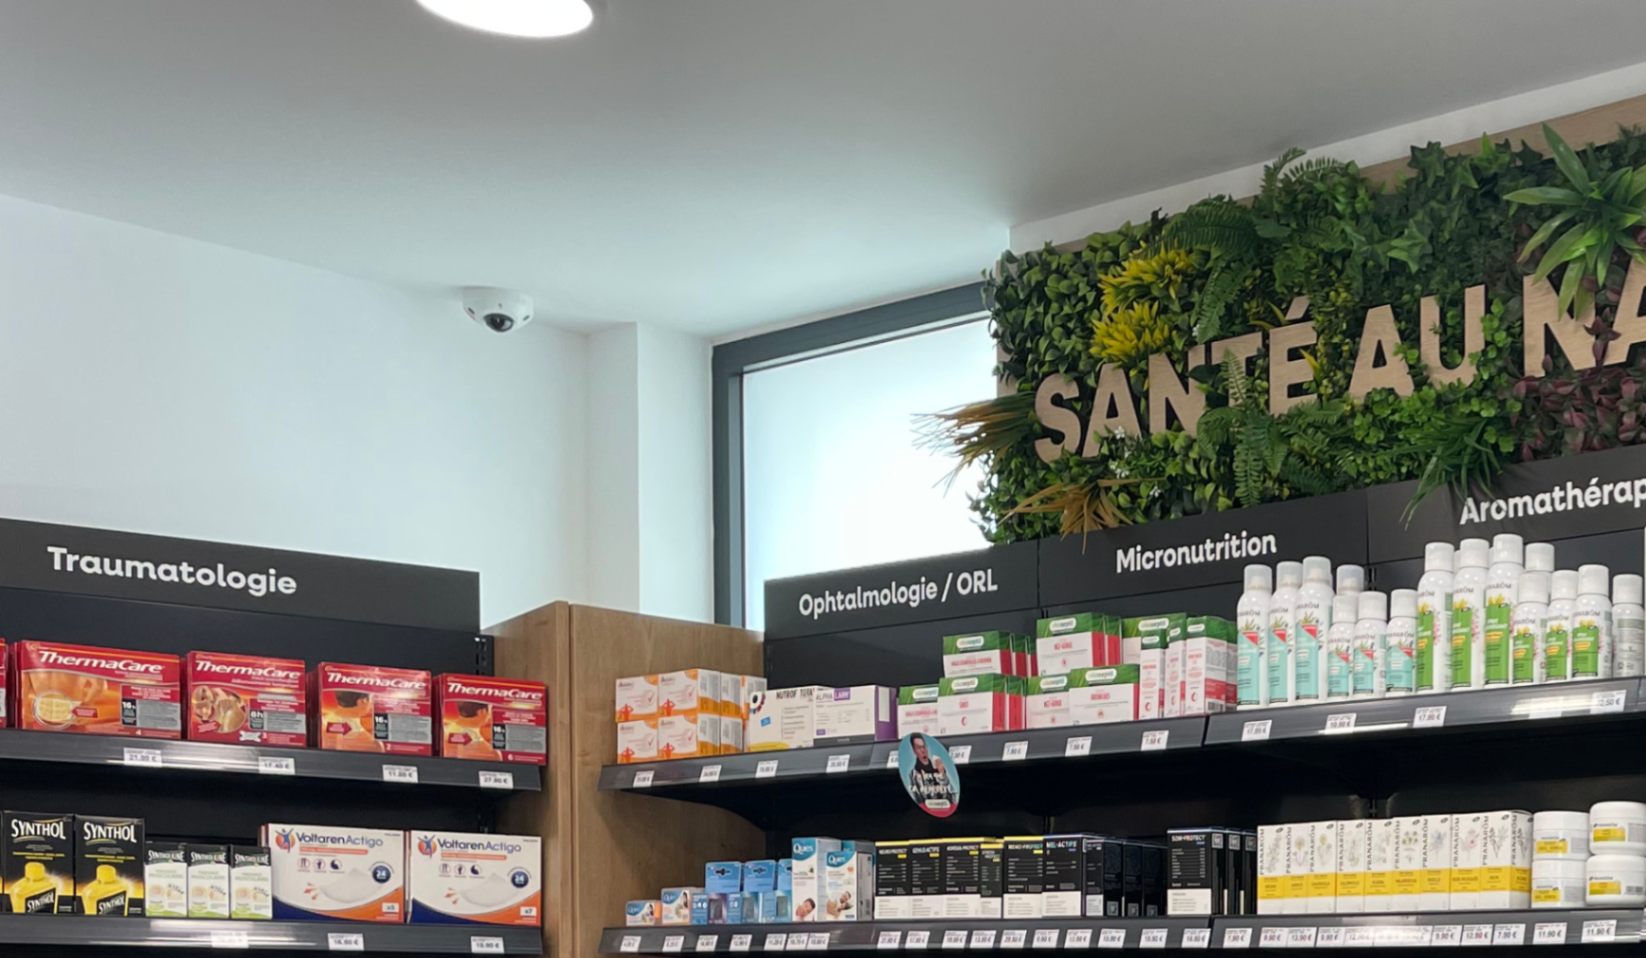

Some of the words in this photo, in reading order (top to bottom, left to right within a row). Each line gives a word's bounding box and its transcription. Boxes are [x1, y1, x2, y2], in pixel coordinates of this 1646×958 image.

[1035, 296, 1318, 463] SANTÉ
[1348, 284, 1486, 398] AU
[1116, 532, 1277, 573] Micronutrition
[47, 546, 297, 596] Traumatologie
[799, 578, 938, 620] Ophtalmologie
[957, 568, 998, 594] ORL
[37, 651, 164, 673] ThermaCare
[195, 660, 300, 679] ThermaCare
[447, 682, 542, 700] ThermaCare
[11, 819, 66, 840] SYNTHOL
[83, 822, 137, 843] SYNTHOL
[296, 832, 383, 847] VoltarenActigo
[437, 838, 521, 854] VoltarenActigo
